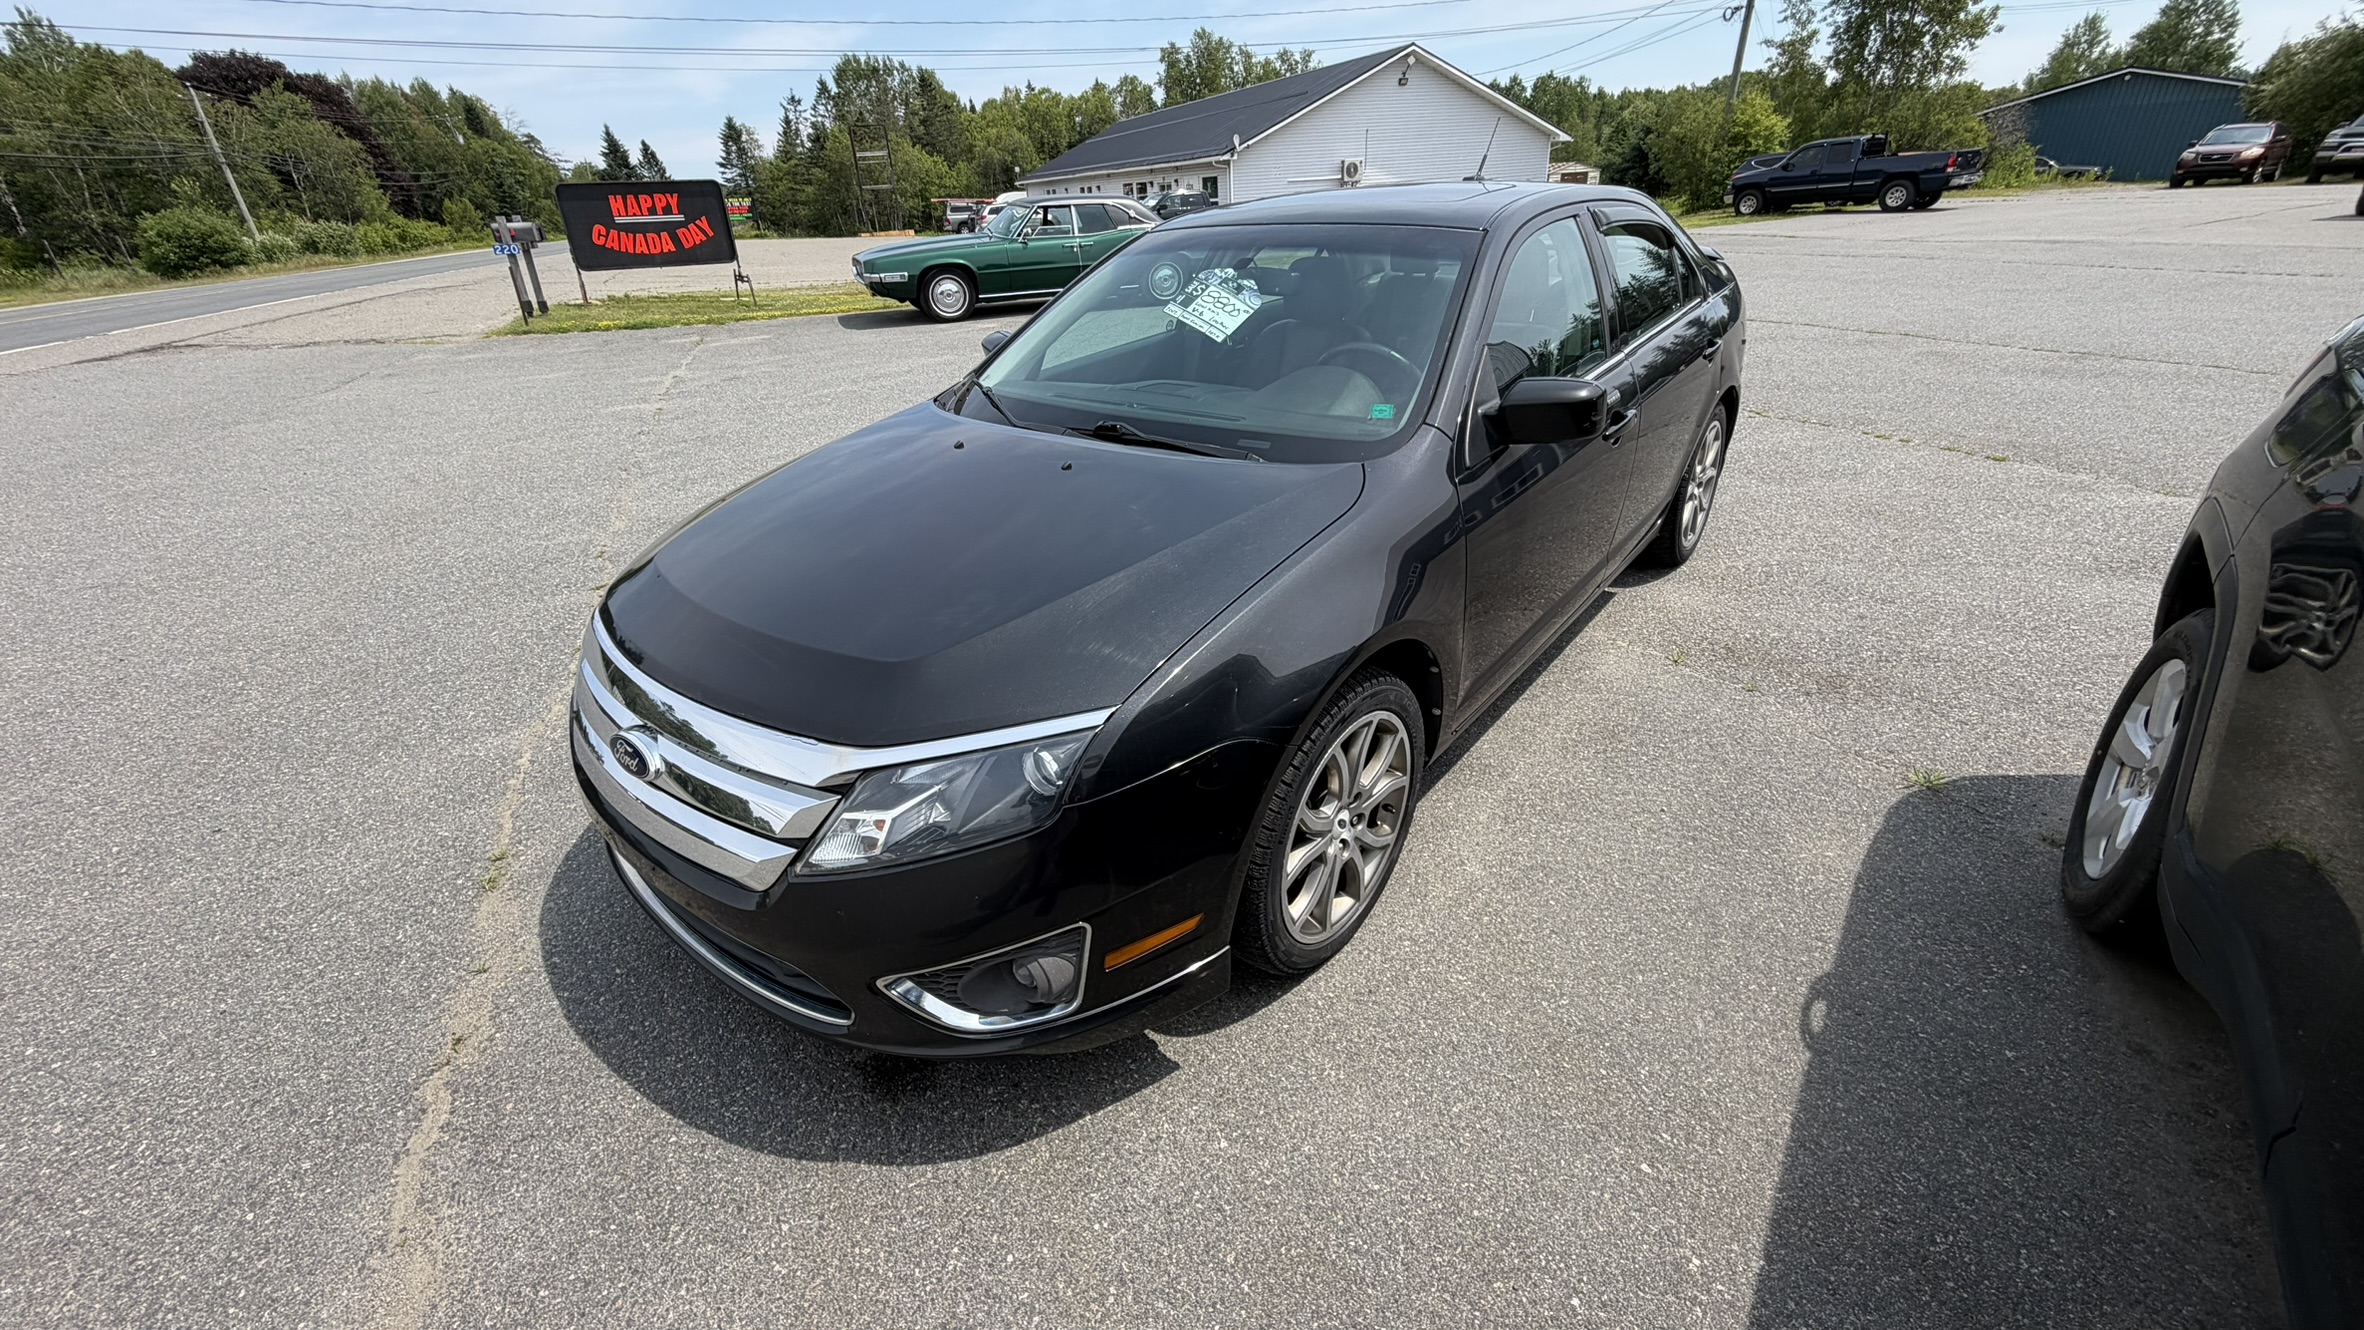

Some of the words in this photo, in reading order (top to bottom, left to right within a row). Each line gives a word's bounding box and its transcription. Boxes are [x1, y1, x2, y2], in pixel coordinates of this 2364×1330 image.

[608, 193, 679, 217] HAPPY
[592, 223, 676, 255] CANADA
[676, 215, 715, 249] DAY
[494, 244, 519, 255] 220
[1184, 279, 1200, 293] SALE
[614, 739, 639, 772] Ford
